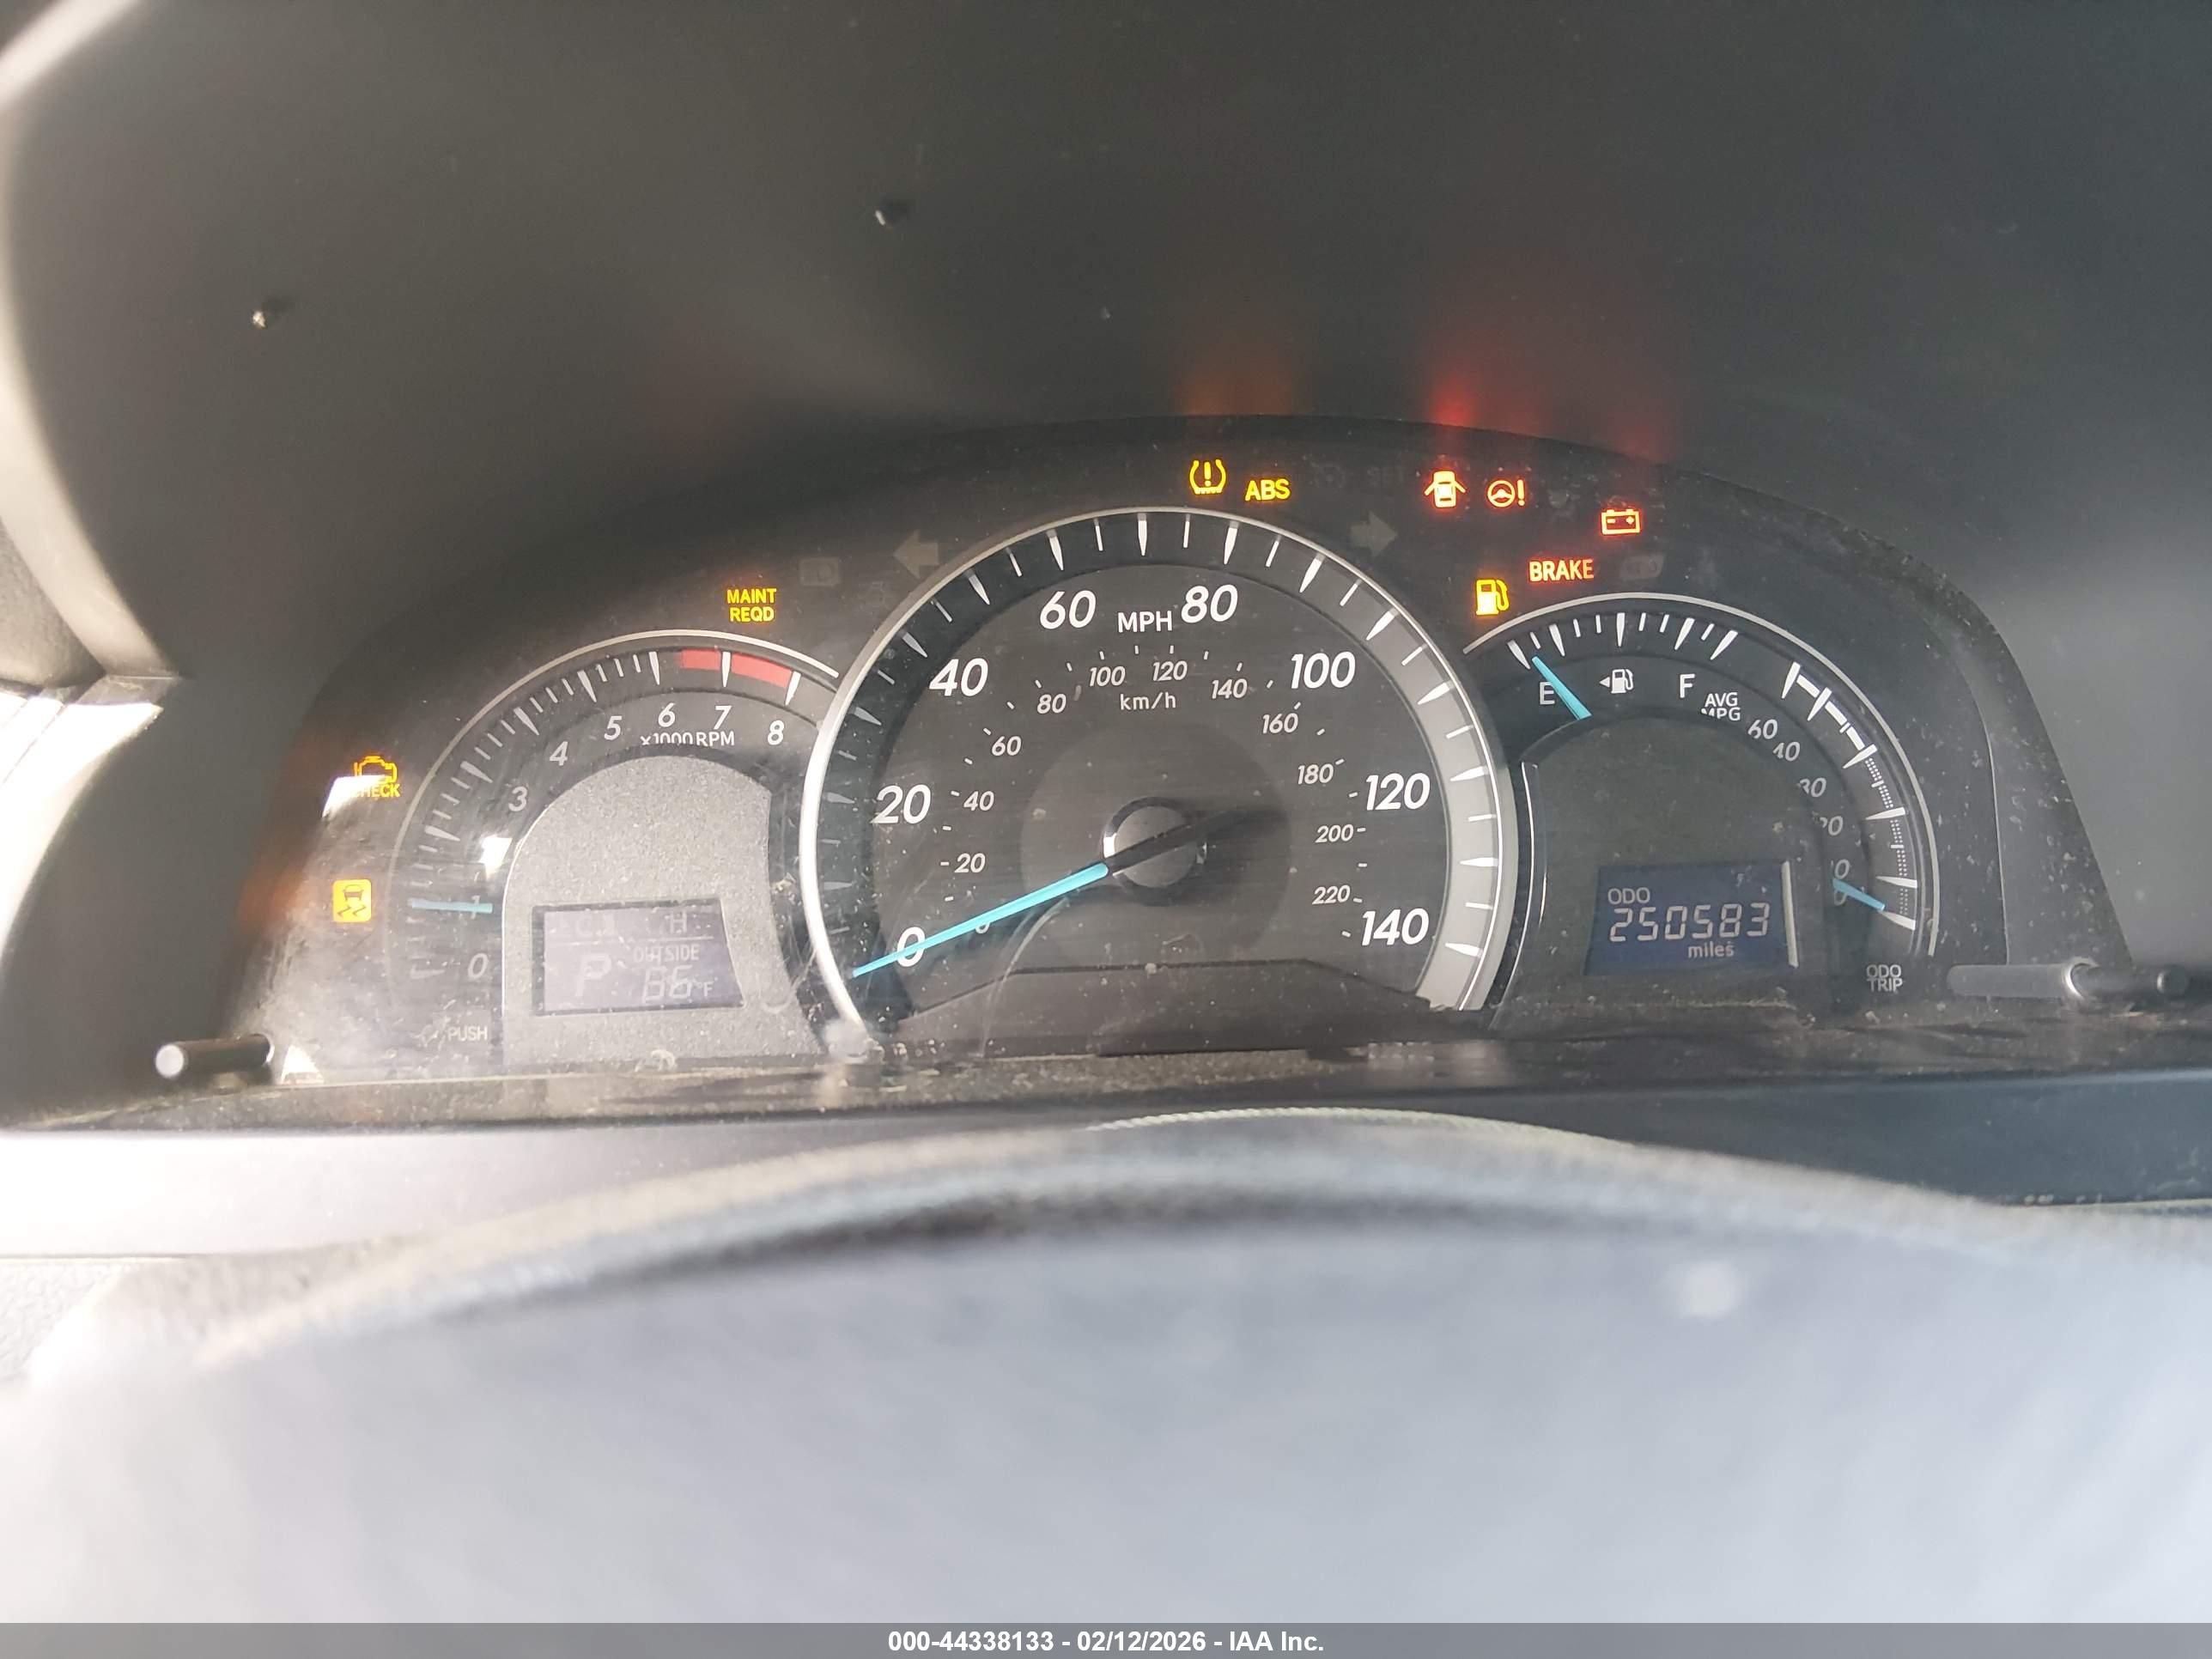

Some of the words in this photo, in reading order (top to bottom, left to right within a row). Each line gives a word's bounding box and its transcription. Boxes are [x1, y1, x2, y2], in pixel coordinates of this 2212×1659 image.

[1244, 478, 1291, 501] ABS
[1528, 559, 1595, 582] BRAKE
[727, 587, 777, 604] MAINT
[1181, 584, 1239, 623] 80
[729, 606, 775, 623] REQD
[1039, 590, 1097, 629] 60
[1117, 611, 1174, 633] MPH
[928, 658, 989, 697] 40
[1089, 665, 1127, 687] 100
[1152, 660, 1188, 682] 120
[1291, 651, 1357, 690] 100
[1212, 678, 1249, 700] 140
[1540, 682, 1556, 705] E
[1680, 673, 1696, 698] F
[1036, 693, 1067, 714] 80
[1120, 692, 1177, 711] km/h
[1704, 691, 1738, 708] AVG
[658, 702, 676, 727] 6
[713, 705, 732, 730] 7
[1262, 713, 1299, 735] 160
[604, 715, 623, 741] 5
[696, 730, 736, 747] RPM
[767, 720, 786, 745] 8
[1747, 719, 1778, 739] 60
[550, 741, 568, 766] 4
[991, 735, 1022, 757] 60
[1297, 763, 1334, 785] 180
[351, 783, 401, 798] HECK
[508, 787, 527, 811] 3
[963, 790, 995, 811] 40
[1364, 773, 1431, 811] 120
[869, 784, 932, 824] 20
[1315, 823, 1354, 843] 200
[954, 853, 986, 873] 20
[1312, 884, 1351, 905] 220
[1607, 886, 1651, 905] ODO
[1361, 908, 1430, 946] 140
[1609, 902, 1771, 942] 250583
[897, 927, 926, 968] 0
[1687, 941, 1735, 959] miles
[467, 952, 489, 979] 0
[1866, 963, 1902, 979] ODO
[1866, 977, 1904, 992] TRIP
[447, 1025, 488, 1042] PUSH
